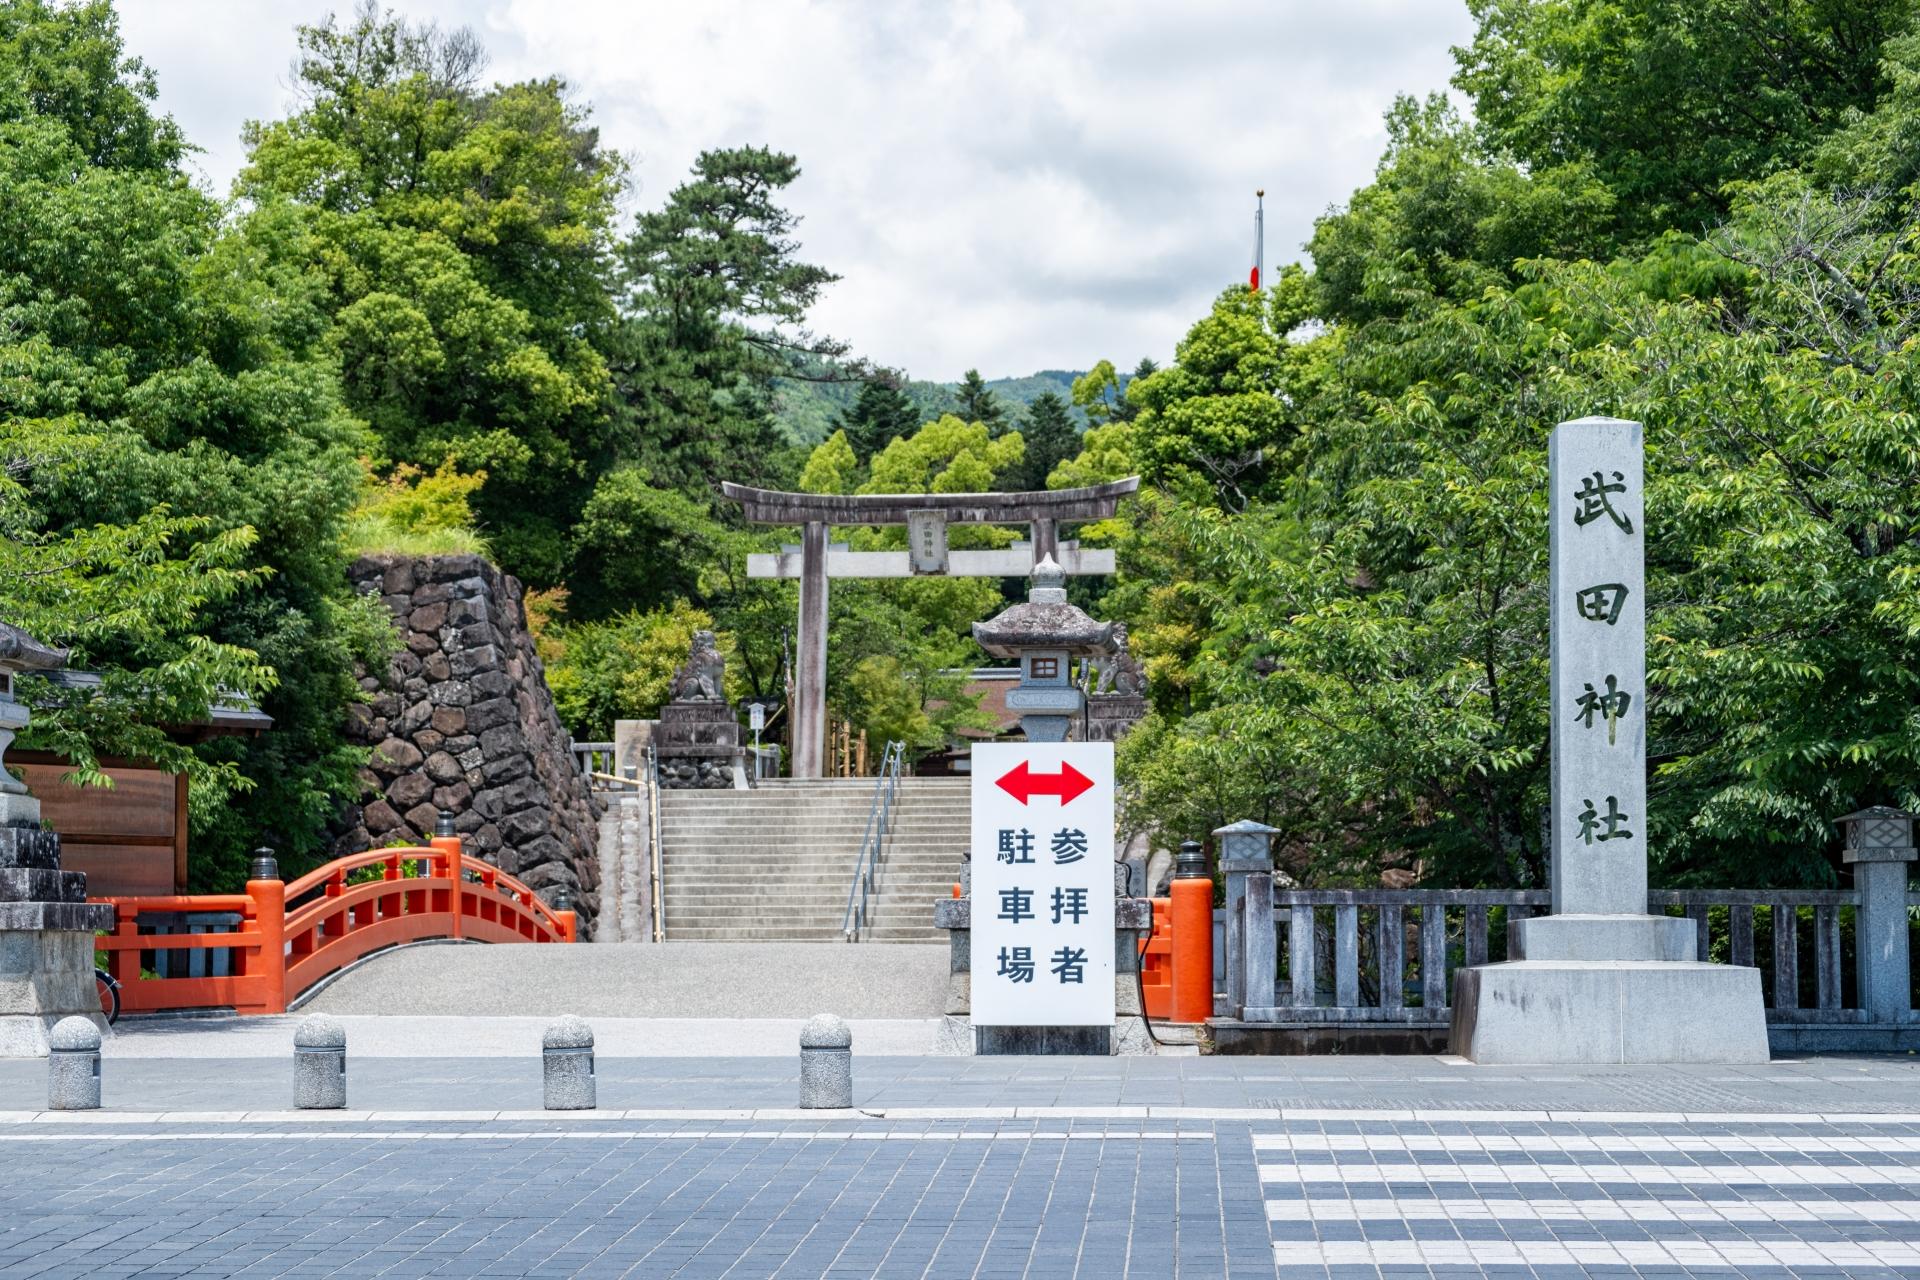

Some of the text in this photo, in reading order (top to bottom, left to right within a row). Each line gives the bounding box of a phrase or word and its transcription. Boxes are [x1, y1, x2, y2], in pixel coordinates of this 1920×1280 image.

[1574, 471, 1634, 846] 武田神社
[996, 827, 1036, 984] 駐車場
[1050, 827, 1089, 984] 参拝者
